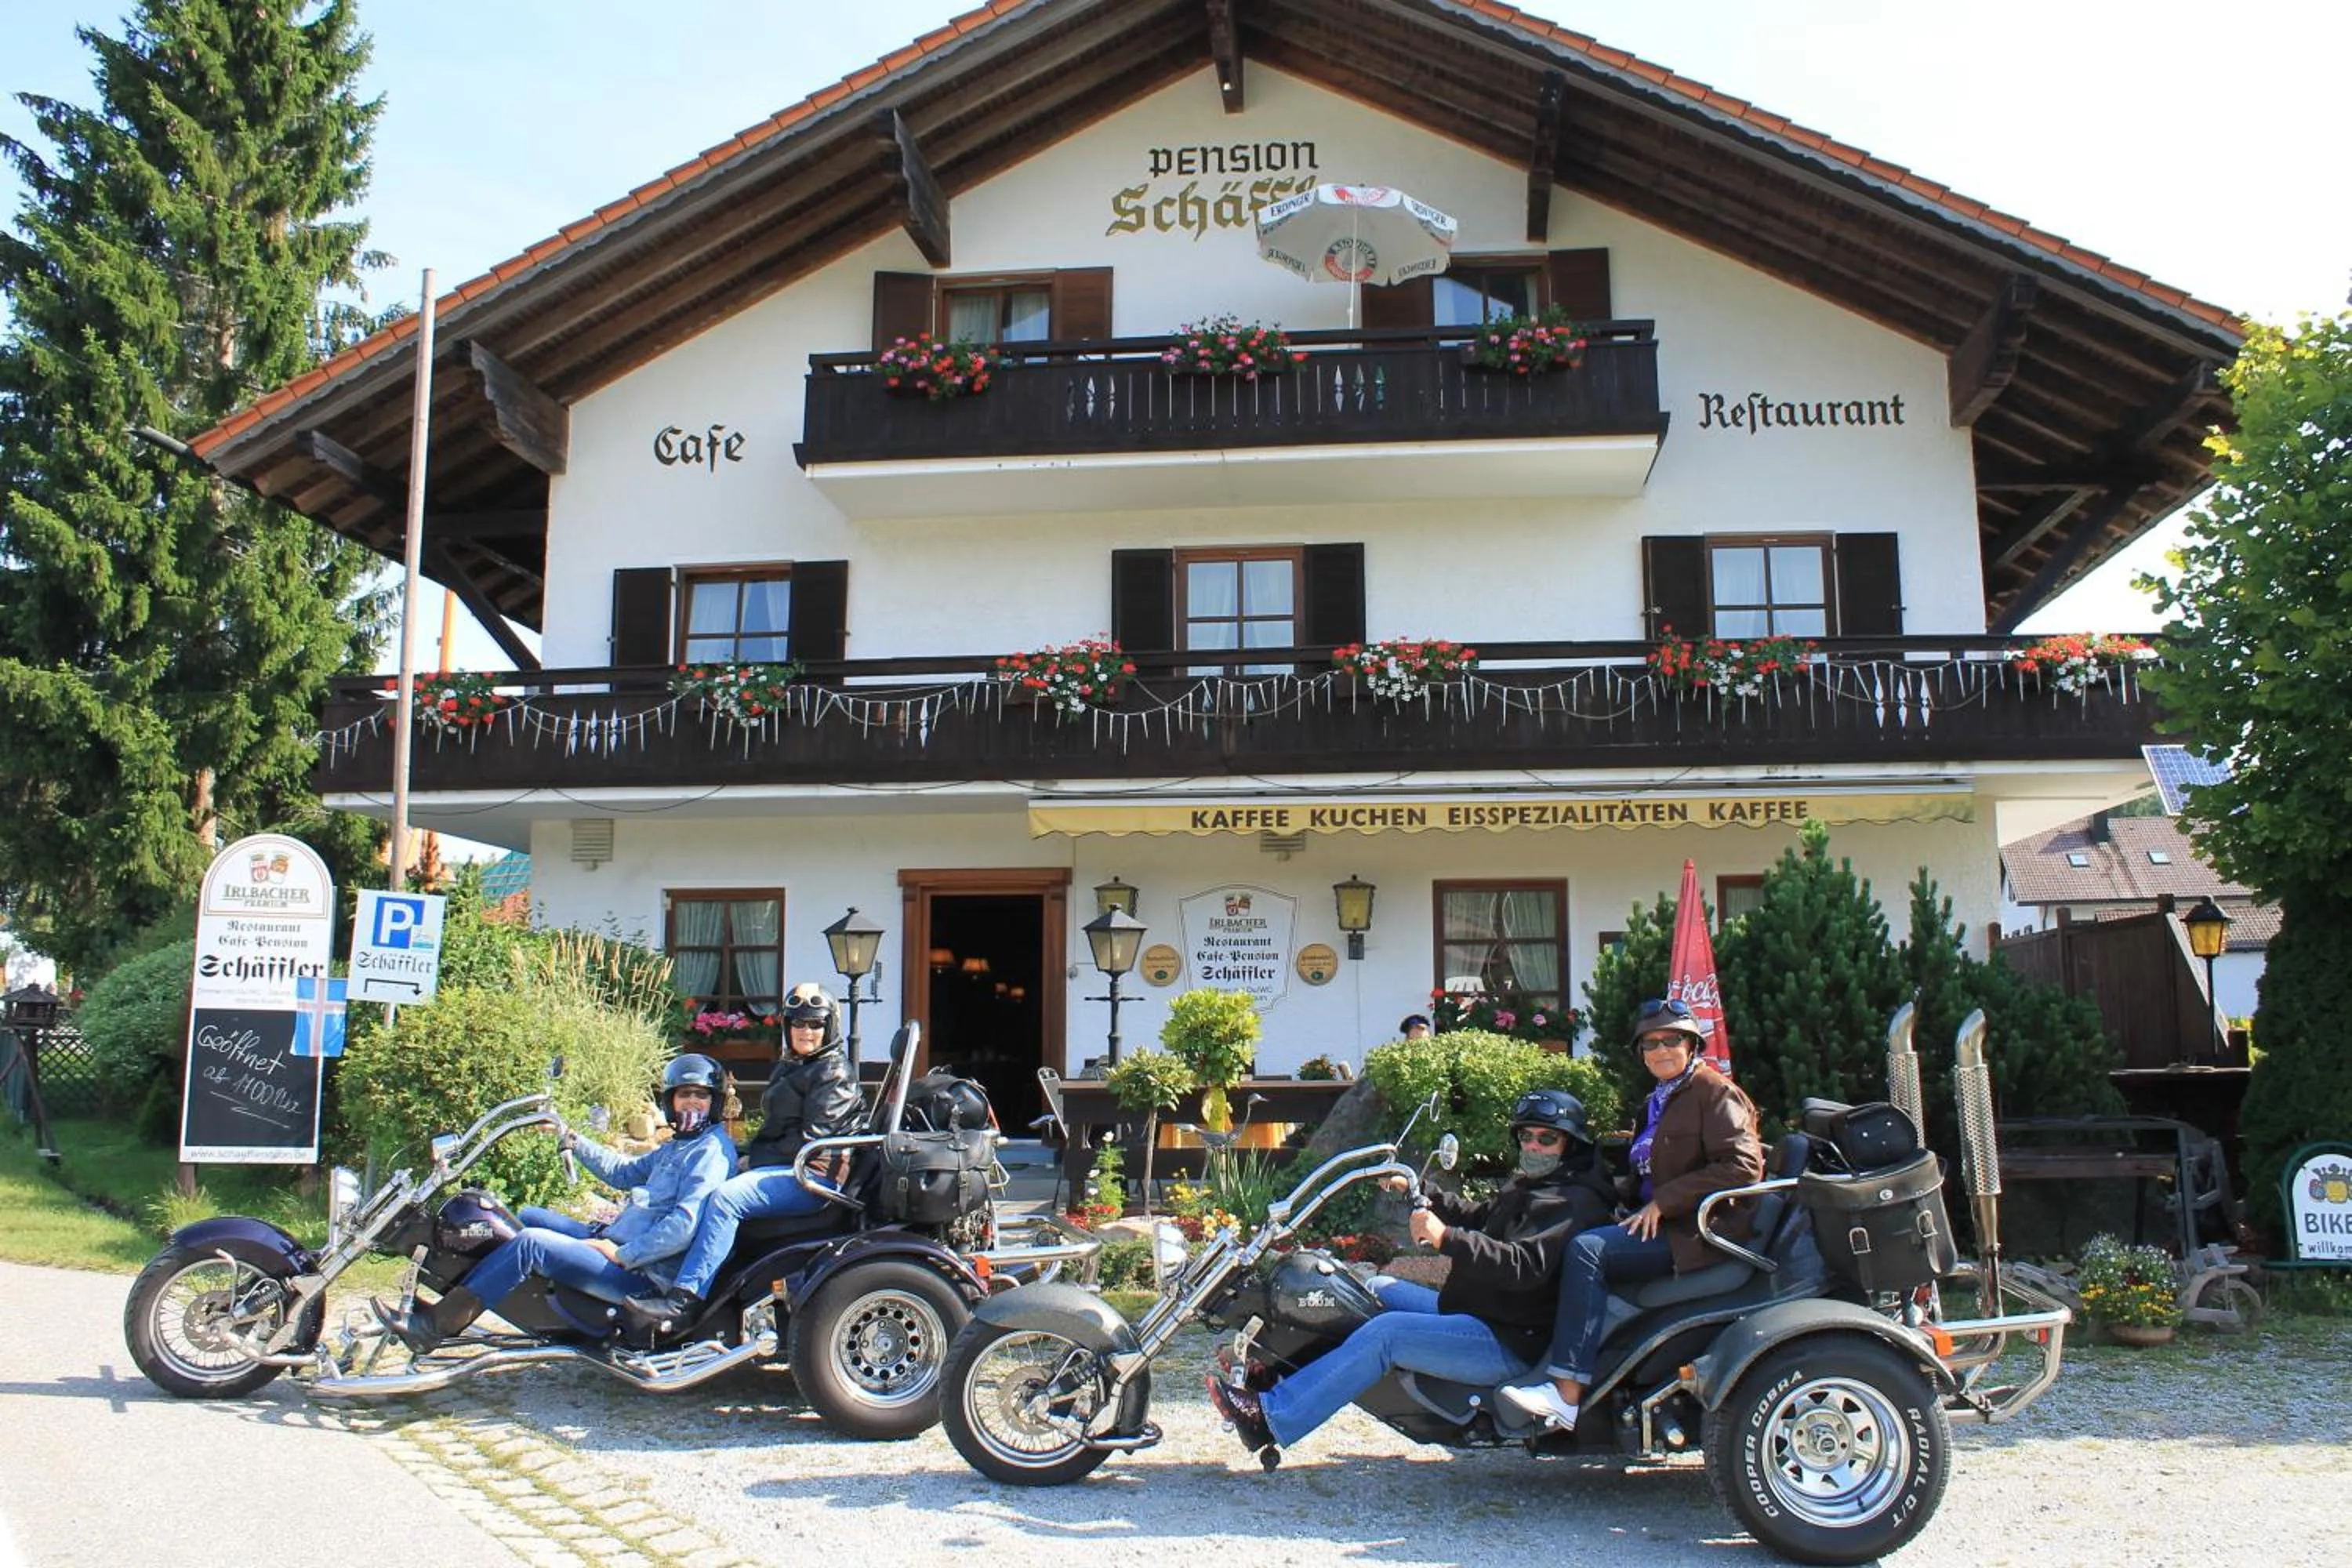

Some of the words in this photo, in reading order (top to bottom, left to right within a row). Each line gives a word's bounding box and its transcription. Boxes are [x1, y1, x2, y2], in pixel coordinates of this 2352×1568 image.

[1269, 191, 1312, 217] ERDINGER
[654, 424, 746, 473] Cafe
[1191, 809, 1290, 829] KAFFEE
[1309, 807, 1427, 826] KUCHEN
[1447, 800, 1688, 826] EISSPEZIALITÄTEN
[1708, 800, 1809, 821] KAFFEE
[224, 884, 310, 903] IRLBACHER
[227, 920, 301, 933] Restaurant
[379, 902, 415, 946] P
[1209, 917, 1268, 928] IRLBACHER
[1203, 936, 1272, 947] Restaurant
[199, 954, 325, 985] Schäffler
[357, 951, 433, 975] Schäffler
[1201, 965, 1276, 982] Schäffler
[197, 1025, 287, 1075] Geöffnet
[203, 1065, 232, 1083] ab
[1751, 1370, 1802, 1428] COBRA
[1907, 1407, 1930, 1488] RADIAL
[1744, 1435, 1780, 1518] COOPER
[1892, 1493, 1918, 1528] G/T
